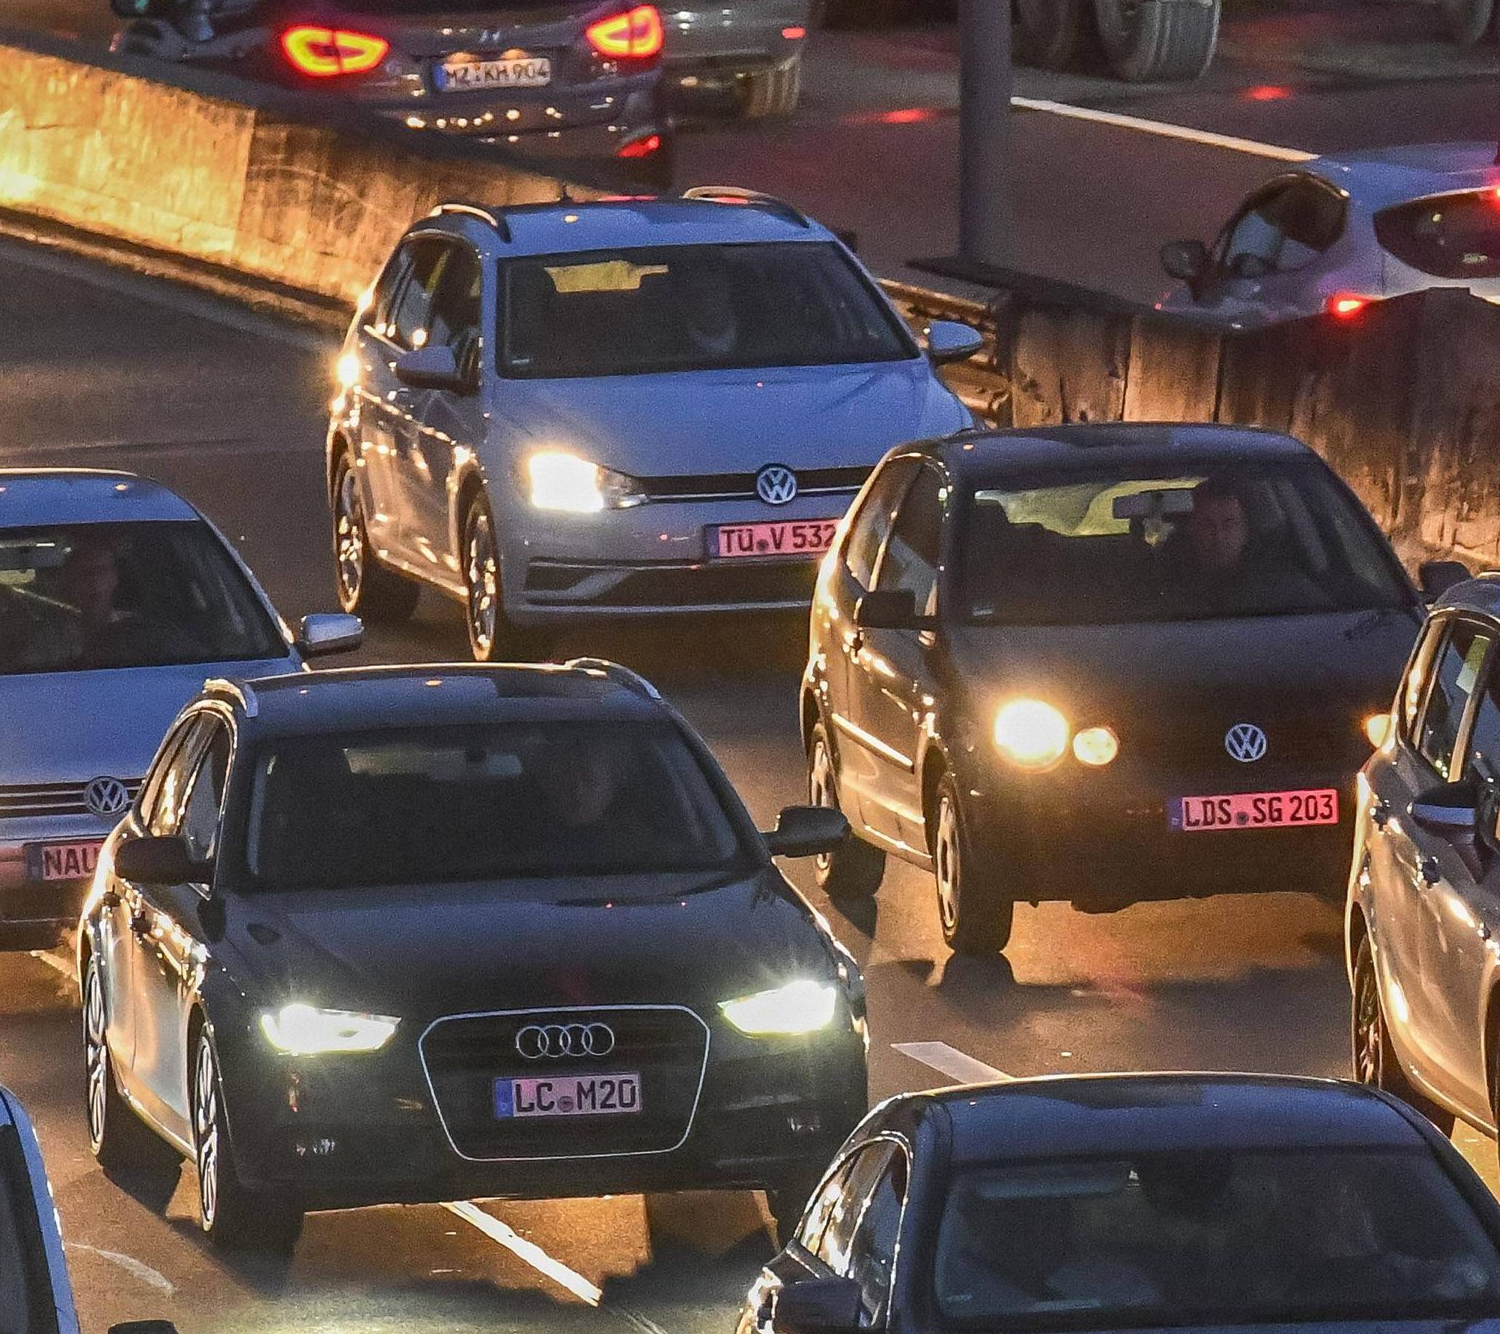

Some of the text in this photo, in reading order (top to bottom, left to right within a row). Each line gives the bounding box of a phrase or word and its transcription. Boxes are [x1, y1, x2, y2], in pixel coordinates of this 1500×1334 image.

[721, 525, 753, 553] TÜ
[770, 525, 786, 548] V
[1185, 794, 1333, 827] LDS SG 203
[44, 845, 100, 877] NAU
[515, 1081, 555, 1113] LC
